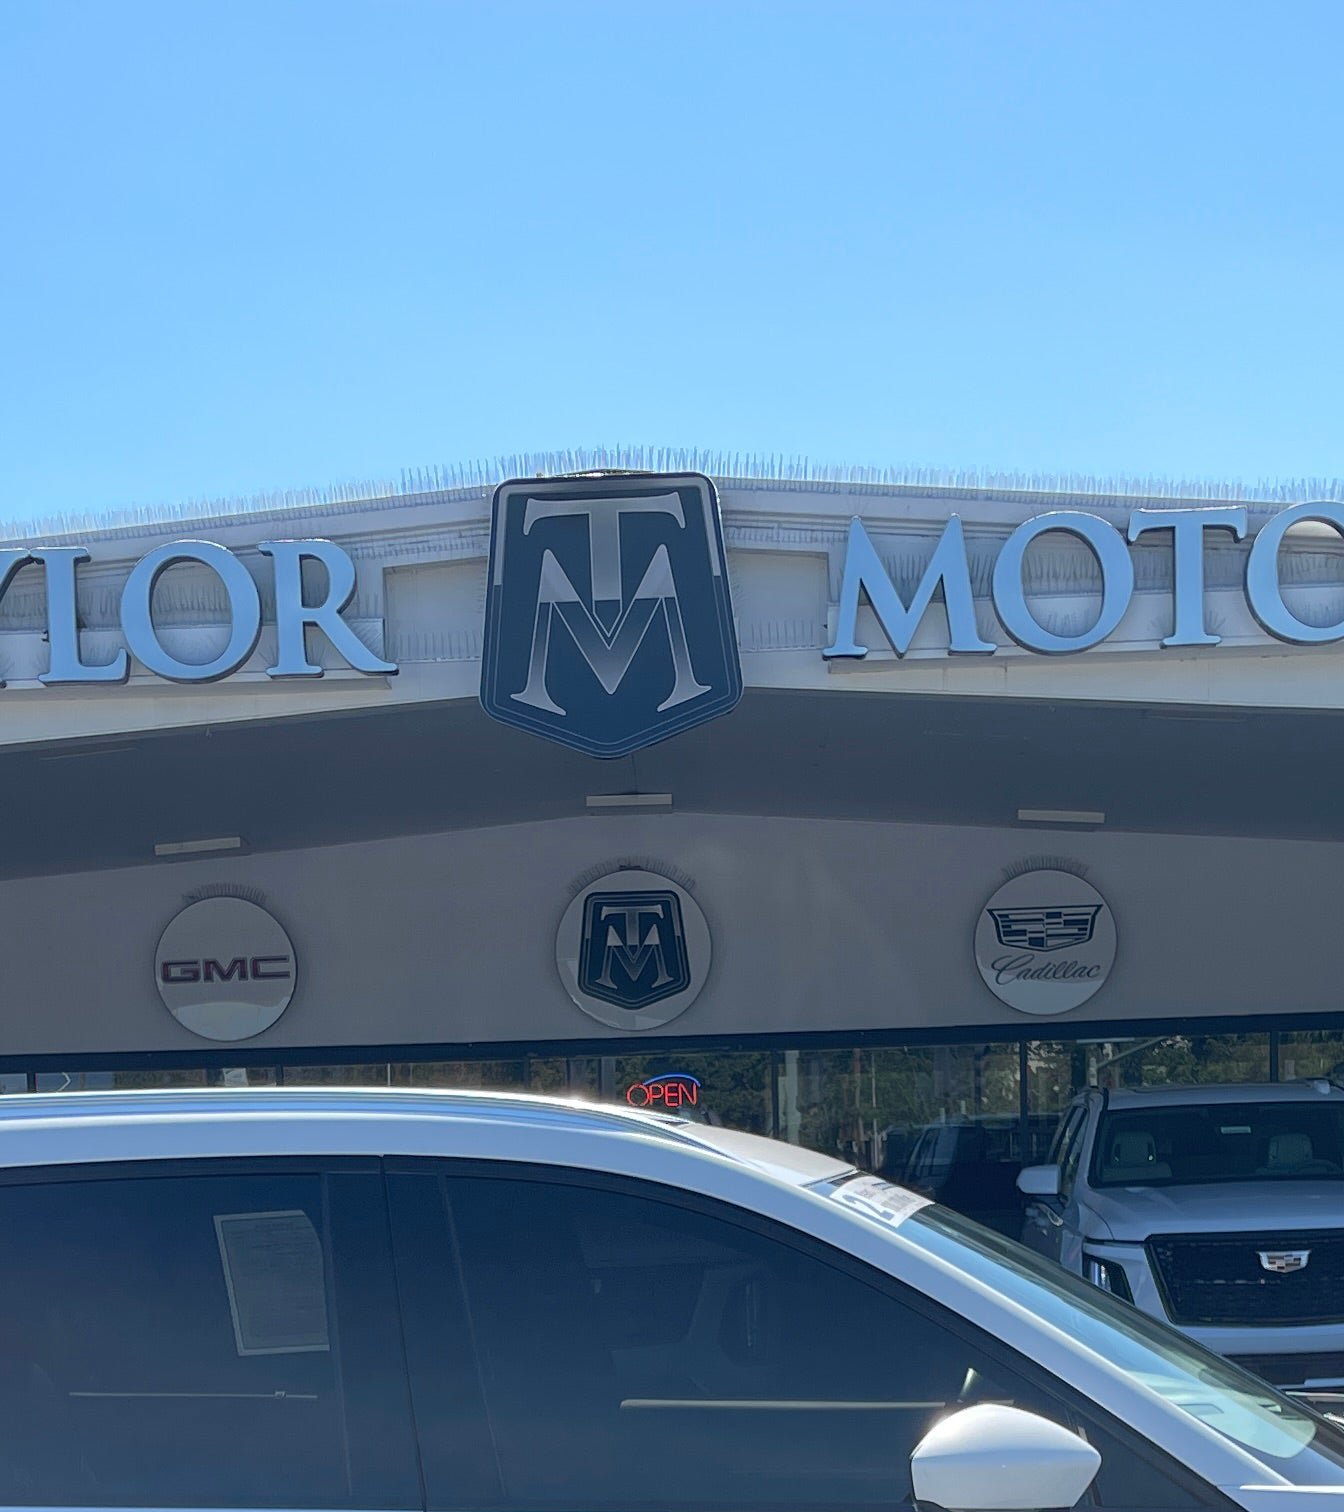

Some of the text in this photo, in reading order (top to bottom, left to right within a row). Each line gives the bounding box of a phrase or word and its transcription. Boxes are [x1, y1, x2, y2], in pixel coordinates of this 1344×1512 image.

[162, 955, 291, 984] GMC
[991, 954, 1100, 985] Cadillac
[626, 1083, 698, 1107] OPEN
